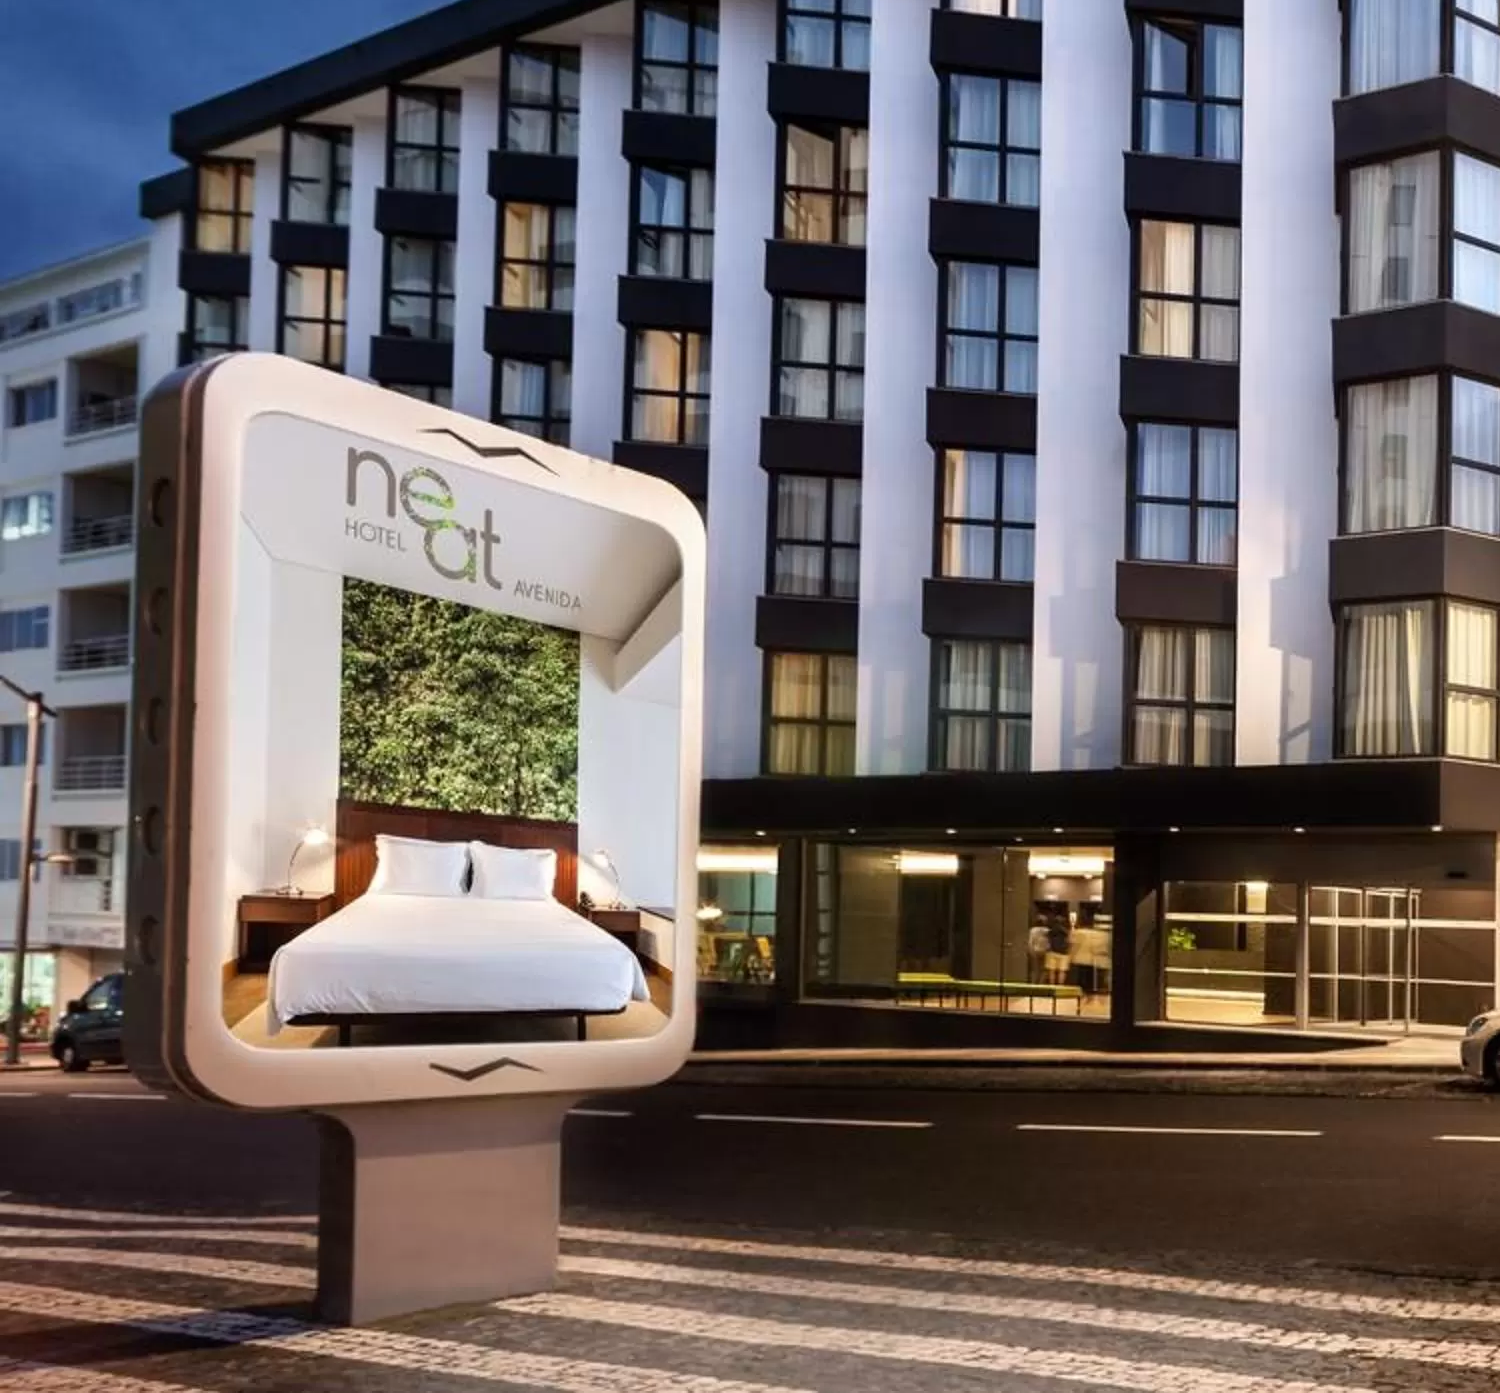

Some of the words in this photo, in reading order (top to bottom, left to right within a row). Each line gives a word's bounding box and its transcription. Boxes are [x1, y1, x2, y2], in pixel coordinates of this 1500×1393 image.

[344, 517, 407, 552] HOTEL
[346, 446, 503, 591] neat
[513, 578, 583, 610] AVENIDA
